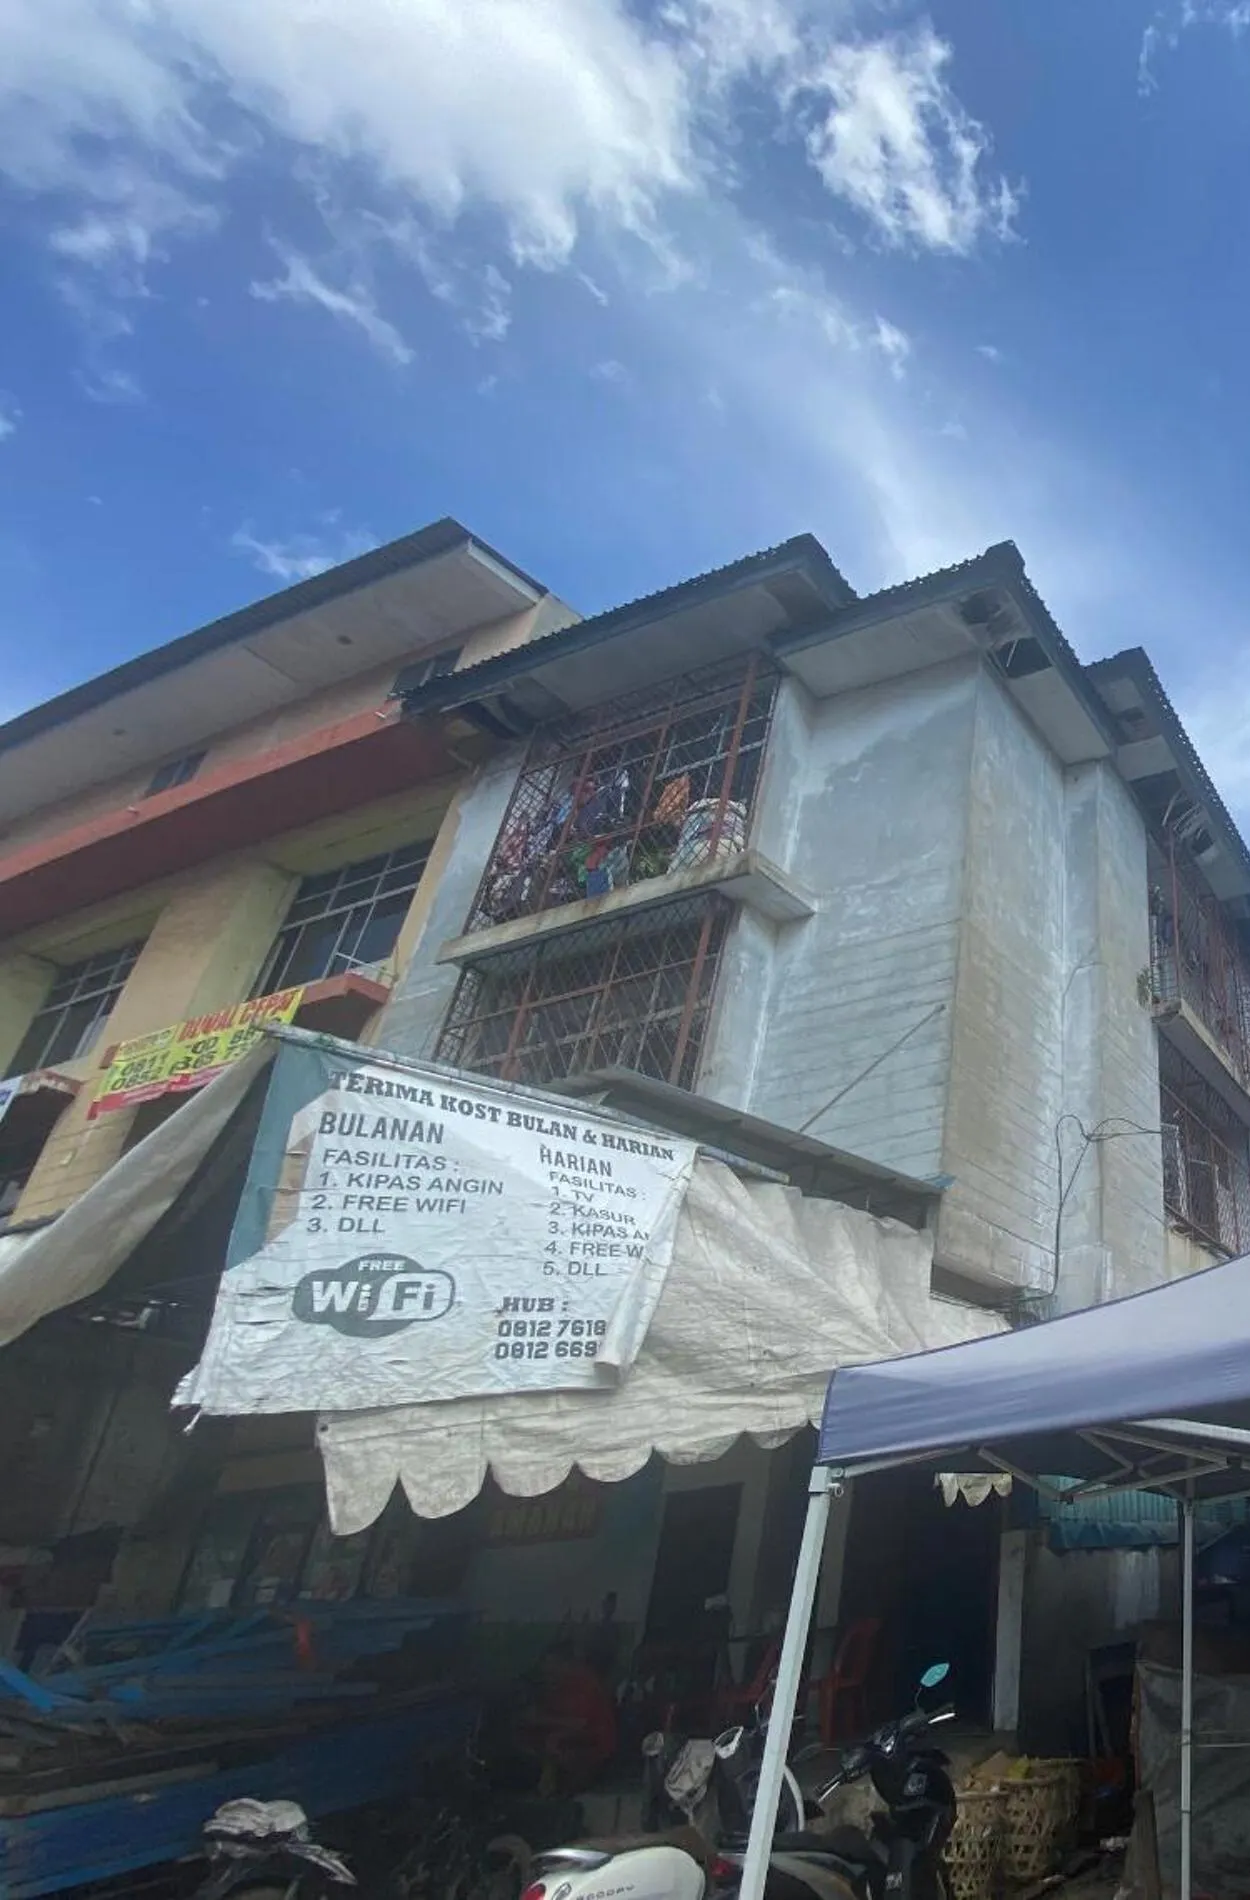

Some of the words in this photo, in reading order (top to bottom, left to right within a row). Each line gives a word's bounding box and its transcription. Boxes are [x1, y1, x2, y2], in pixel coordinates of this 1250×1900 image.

[329, 1071, 434, 1107] TERIMA
[440, 1094, 501, 1123] KOST
[506, 1111, 577, 1142] BULAN
[582, 1129, 597, 1145] &
[600, 1132, 674, 1161] HARIAN
[318, 1111, 444, 1144] BULANAN
[323, 1149, 447, 1171] FASILITAS
[539, 1144, 612, 1177] HARIAN
[319, 1171, 338, 1187] 1.
[346, 1172, 421, 1191] KIPAS
[427, 1177, 504, 1195] ANGIN
[549, 1171, 637, 1199] FASILITAS
[311, 1194, 333, 1210] 2.
[342, 1195, 409, 1212] FREE
[415, 1198, 466, 1214] WIFI
[570, 1189, 594, 1202] TV
[549, 1201, 566, 1216] 2.
[572, 1205, 636, 1225] KASUR
[306, 1217, 328, 1233] 3.
[338, 1217, 386, 1233] DLL
[547, 1221, 564, 1235] 3.
[571, 1222, 628, 1239] KIPAS
[544, 1241, 562, 1254] 4.
[569, 1242, 621, 1257] FREE
[358, 1260, 406, 1271] FREE
[543, 1261, 560, 1276] 5.
[567, 1261, 608, 1276] DLL
[502, 1296, 555, 1312] HUB
[498, 1320, 551, 1337] 0812
[556, 1320, 606, 1337] 7618
[495, 1341, 549, 1359] 0812
